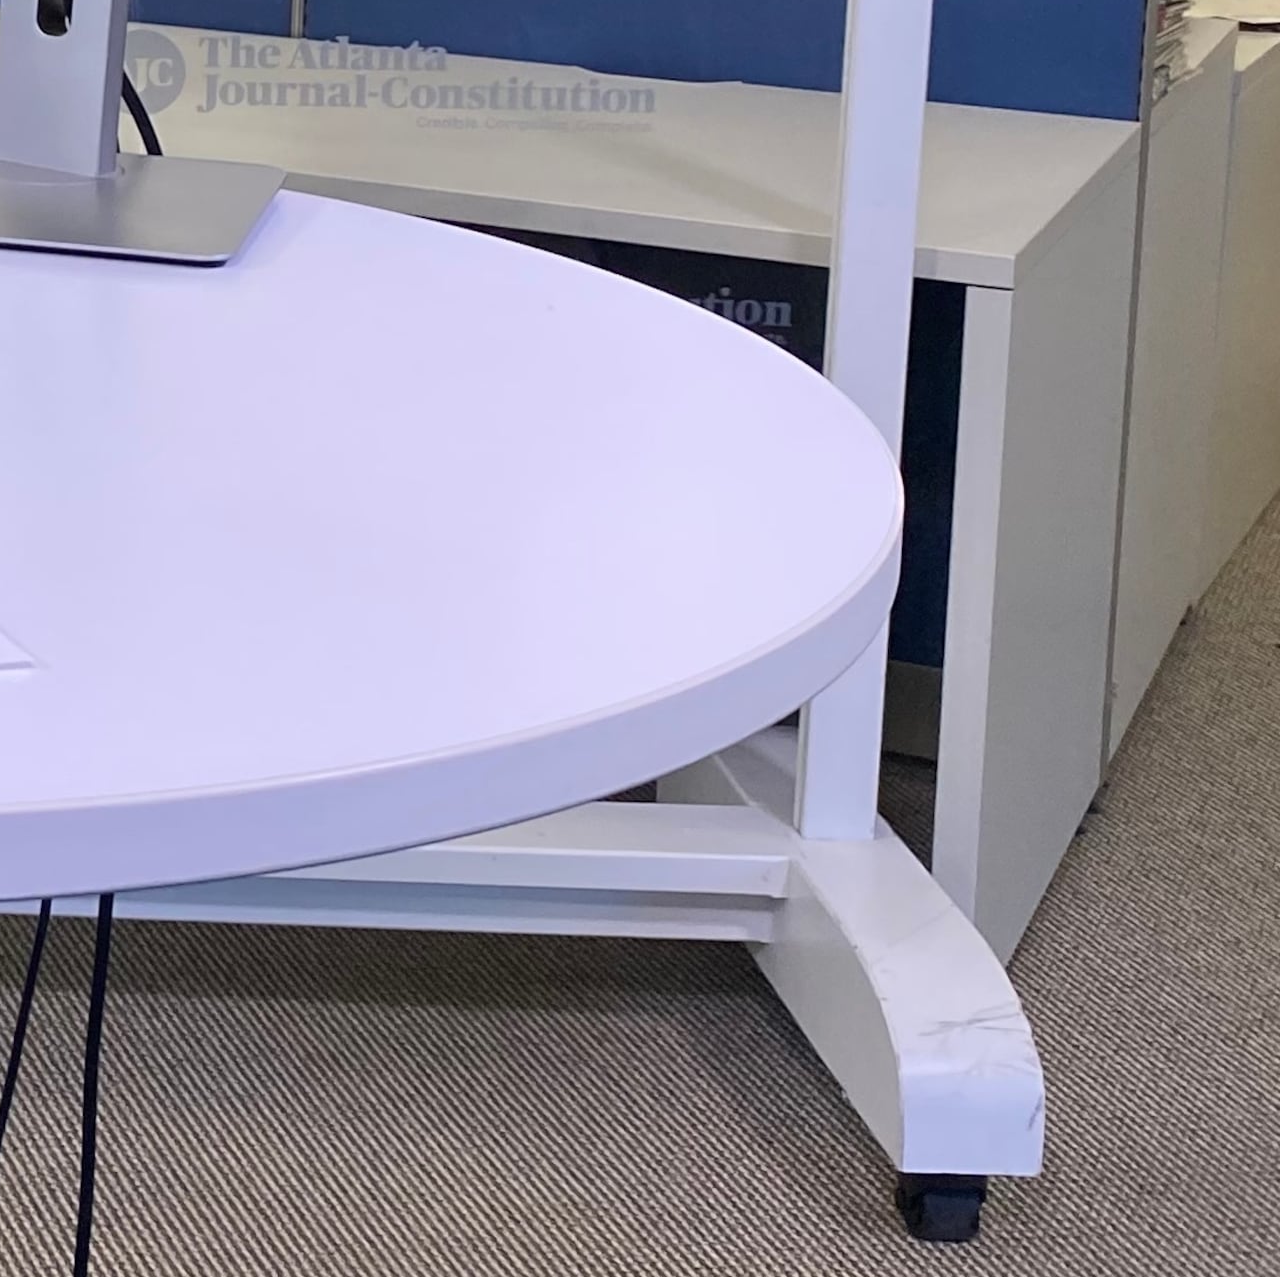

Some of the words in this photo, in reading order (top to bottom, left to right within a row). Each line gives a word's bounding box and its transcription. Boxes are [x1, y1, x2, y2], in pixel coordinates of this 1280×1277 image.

[198, 36, 282, 71] The
[287, 35, 449, 72] Atlanta
[196, 72, 657, 115] Journal-Constitution
